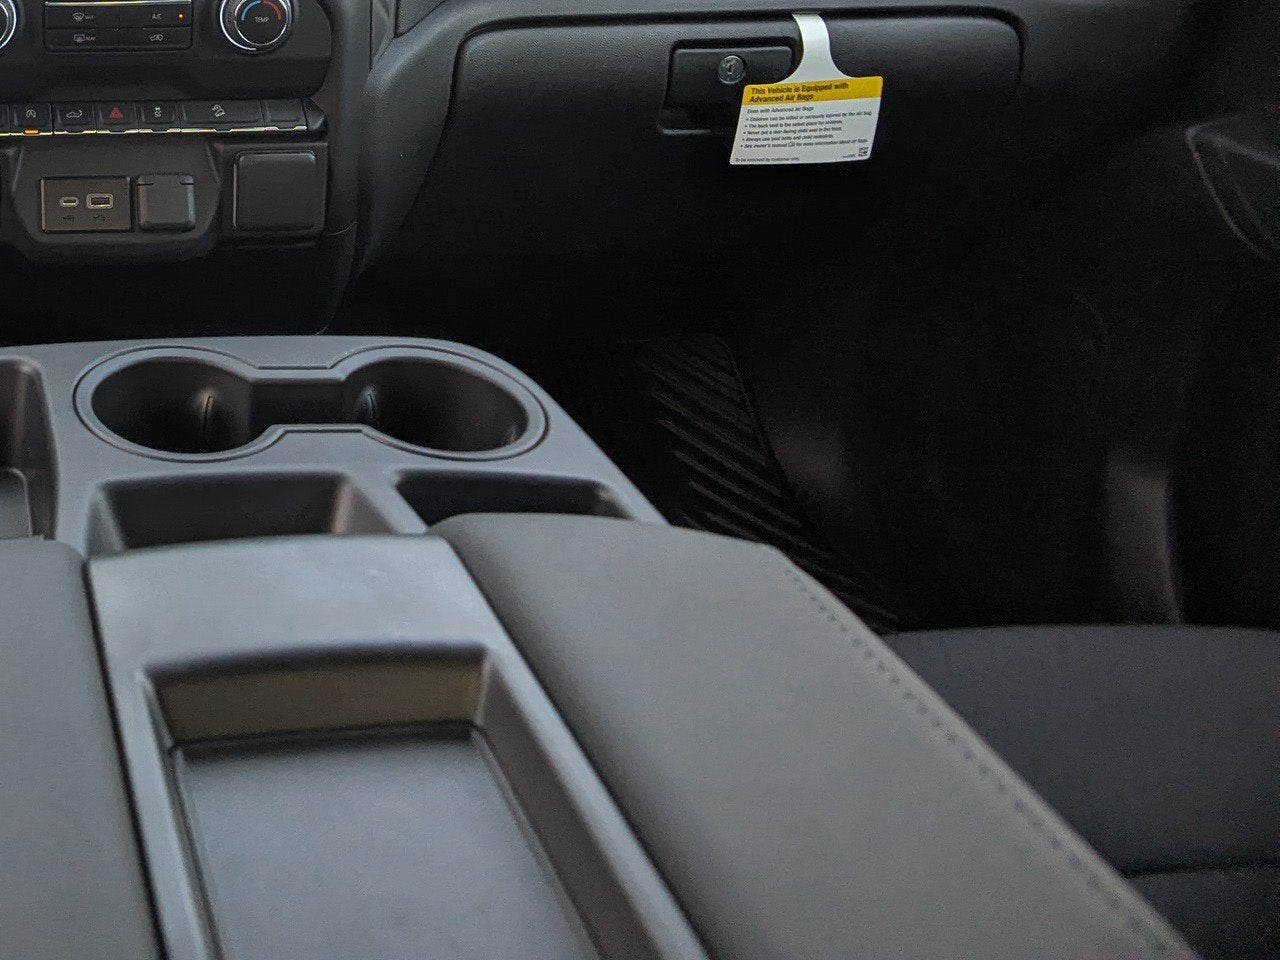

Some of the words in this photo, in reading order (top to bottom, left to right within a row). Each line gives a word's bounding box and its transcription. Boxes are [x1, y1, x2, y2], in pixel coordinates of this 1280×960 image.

[751, 87, 766, 95] This
[767, 86, 792, 94] Vehicle
[801, 84, 833, 93] Equipped
[834, 82, 849, 90] with
[749, 95, 784, 103] Advanced
[796, 93, 814, 102] Bags
